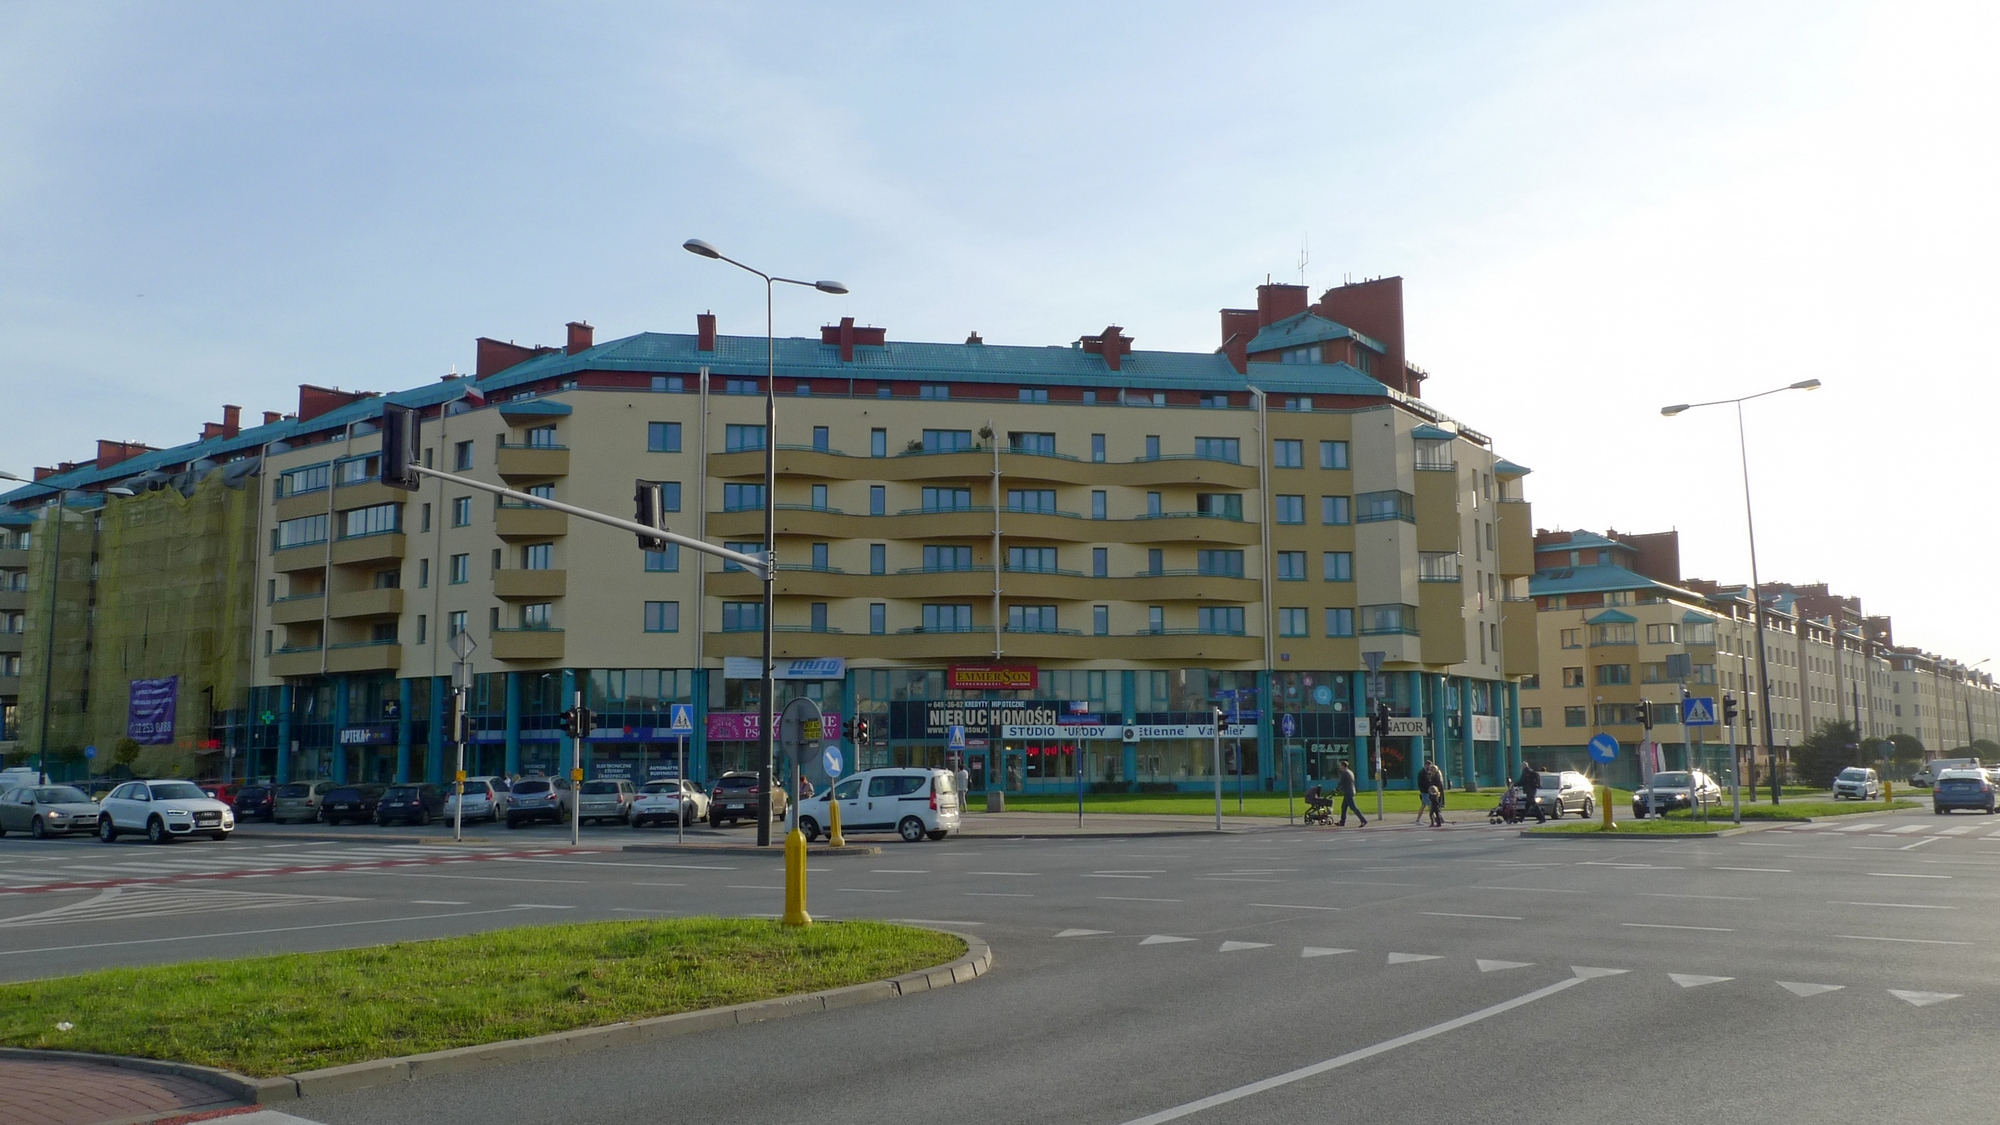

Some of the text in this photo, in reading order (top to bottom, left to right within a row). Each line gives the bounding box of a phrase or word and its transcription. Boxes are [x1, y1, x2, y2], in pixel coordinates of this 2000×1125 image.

[957, 669, 1029, 684] EMMERSON
[929, 706, 1056, 726] NIERUCHOMOŚCI
[341, 729, 365, 744] APTEKA
[1010, 726, 1105, 737] STUDIO URODY
